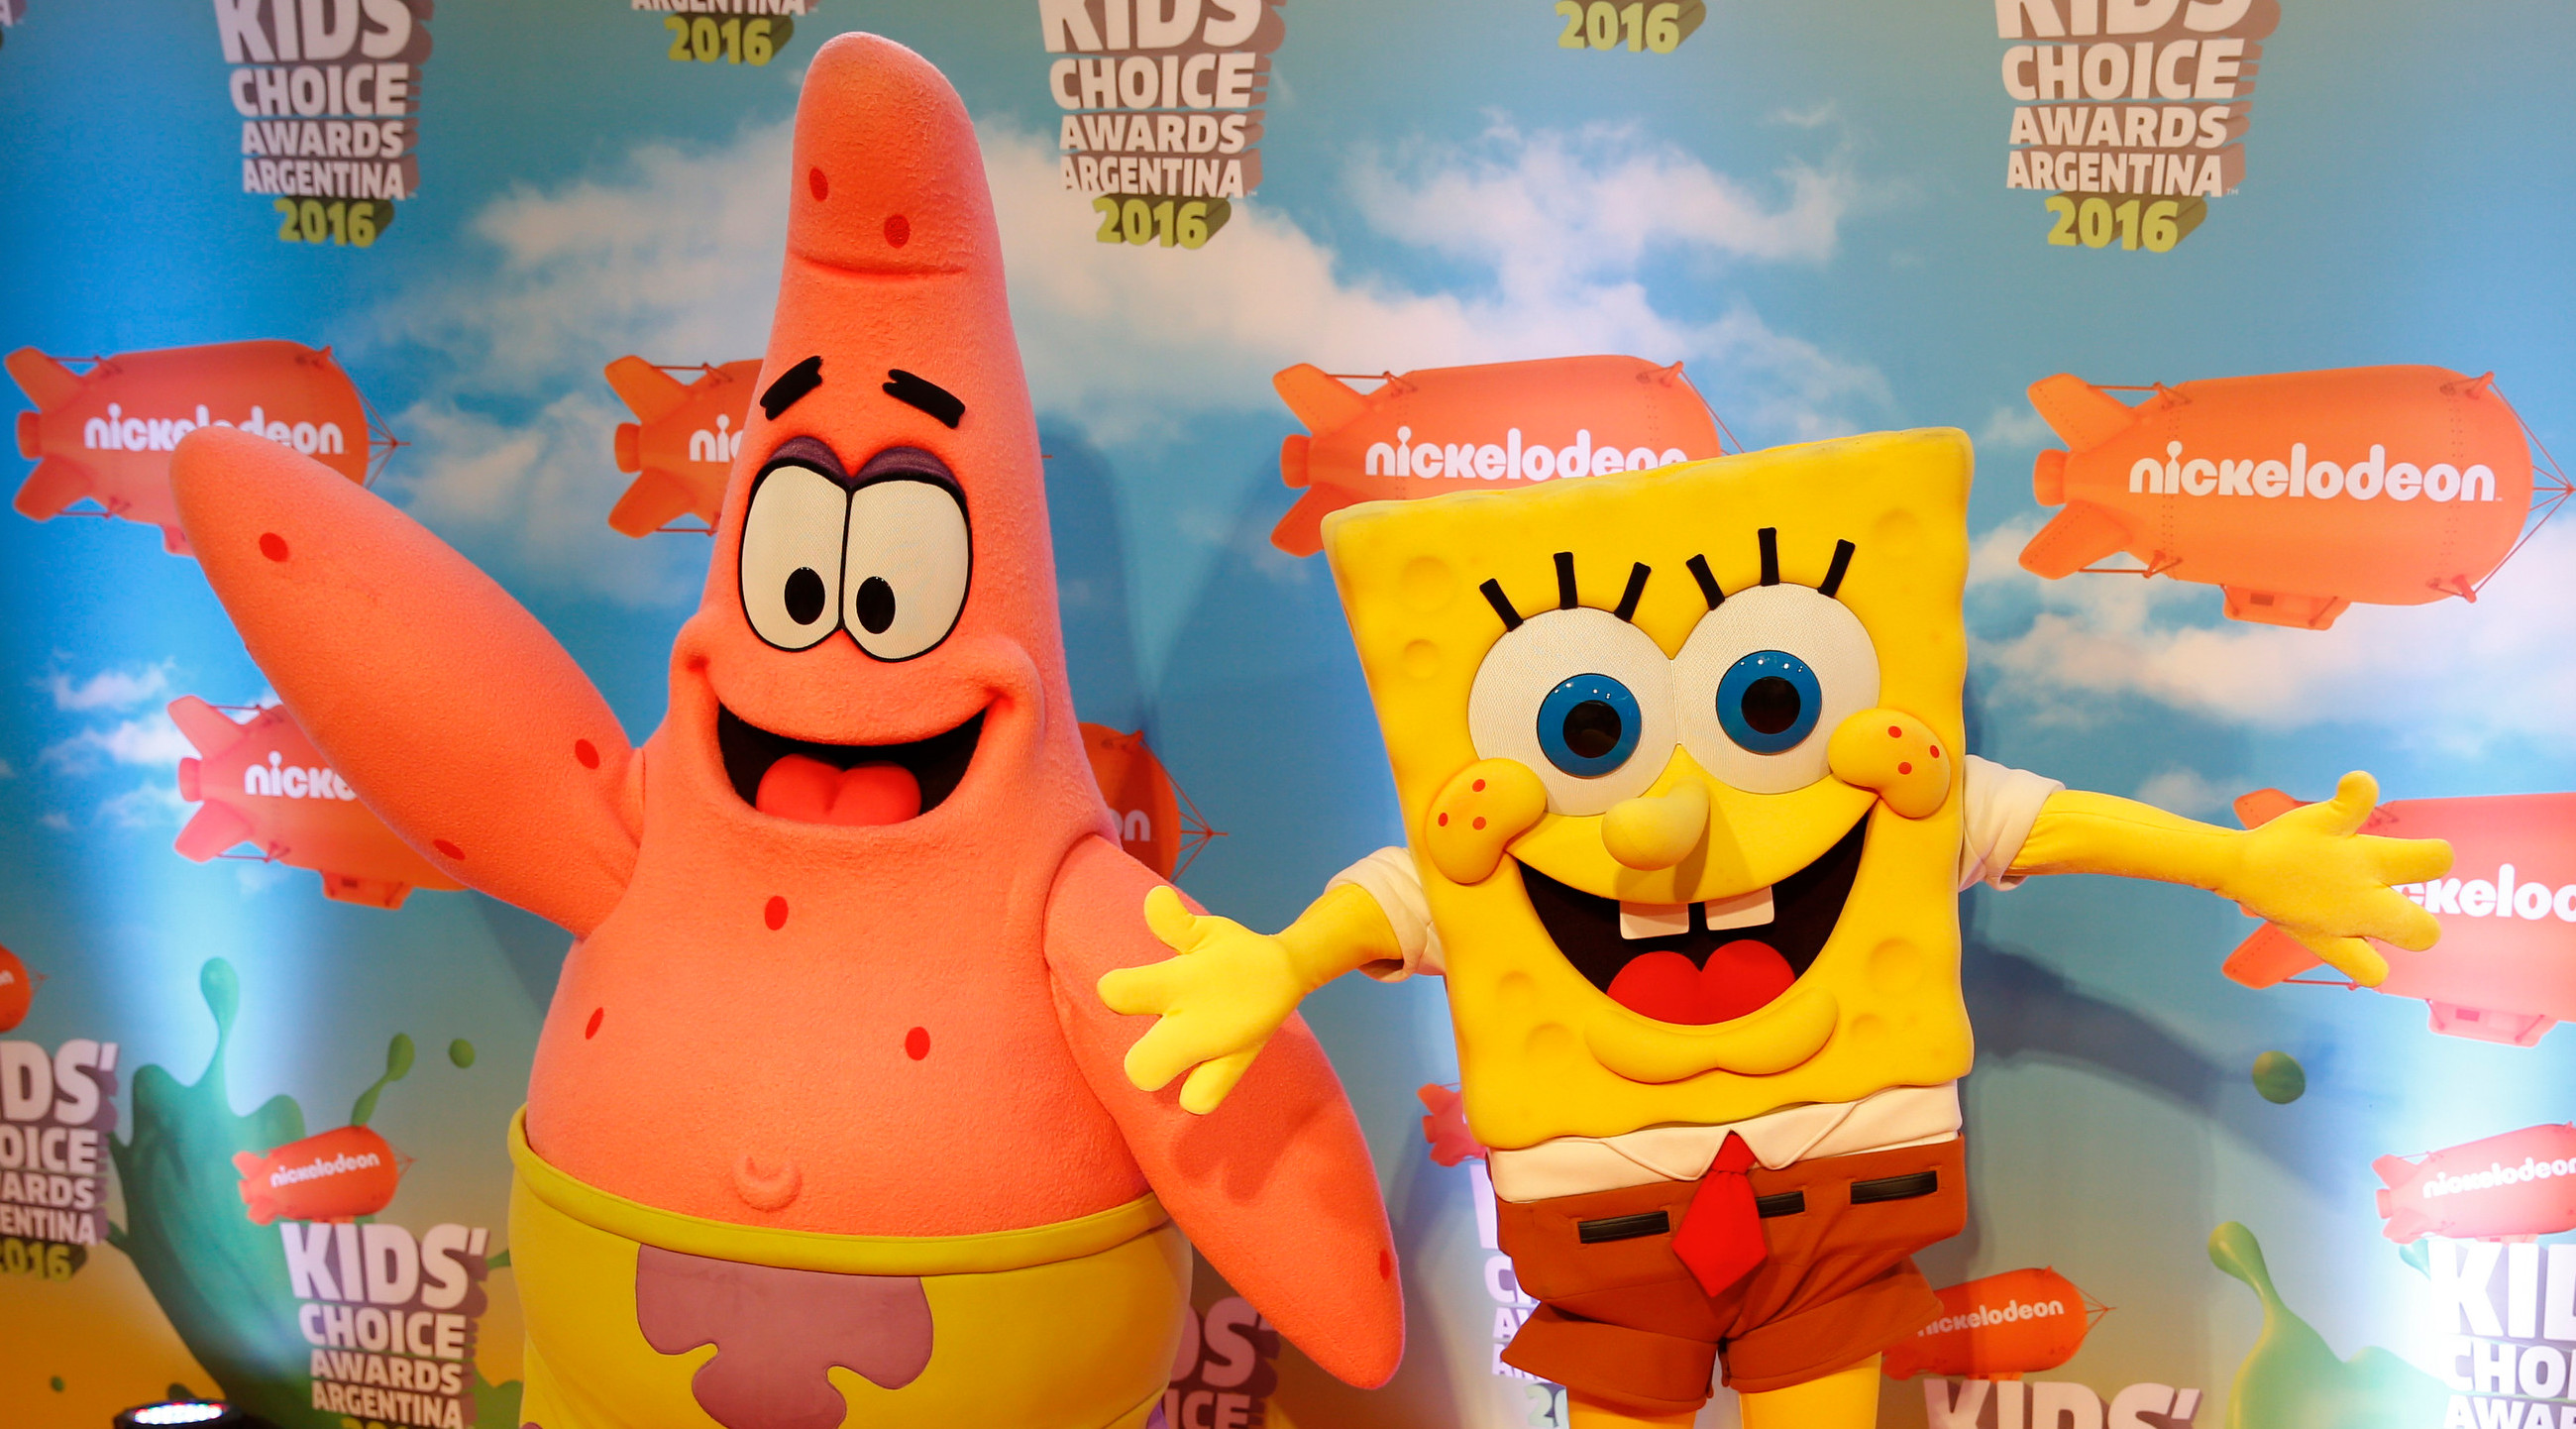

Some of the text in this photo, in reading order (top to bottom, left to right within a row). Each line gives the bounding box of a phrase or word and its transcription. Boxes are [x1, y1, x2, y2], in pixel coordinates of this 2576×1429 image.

[663, 16, 773, 66] 2016
[1555, 0, 1680, 55] 2016
[230, 62, 409, 117] CHOICE
[1049, 53, 1256, 110] CHOICE
[2001, 38, 2245, 101] CHOICE
[242, 120, 404, 159] AWARDS
[1059, 114, 1247, 155] AWARDS
[2008, 105, 2230, 149] AWARDS
[243, 159, 405, 201] ARGENTINA
[1060, 156, 1244, 199] ARGENTINA
[2006, 151, 2222, 198] ARGENTINA
[273, 198, 376, 248] 2016
[1092, 197, 1208, 250] 2016
[2044, 196, 2180, 254] 2016
[2128, 440, 2496, 502] nickelodeon
[0, 1038, 118, 1126] DS'
[0, 1124, 98, 1175] OICE
[269, 1152, 380, 1188] nickelodeon
[0, 1169, 95, 1211] ARDS
[0, 1203, 96, 1246] ENTINA
[0, 1238, 71, 1282] 016
[279, 1222, 488, 1310] KIDS'
[298, 1302, 467, 1360] CHOICE
[310, 1348, 463, 1395] AWARDS
[311, 1379, 464, 1429] ARGENTINA
